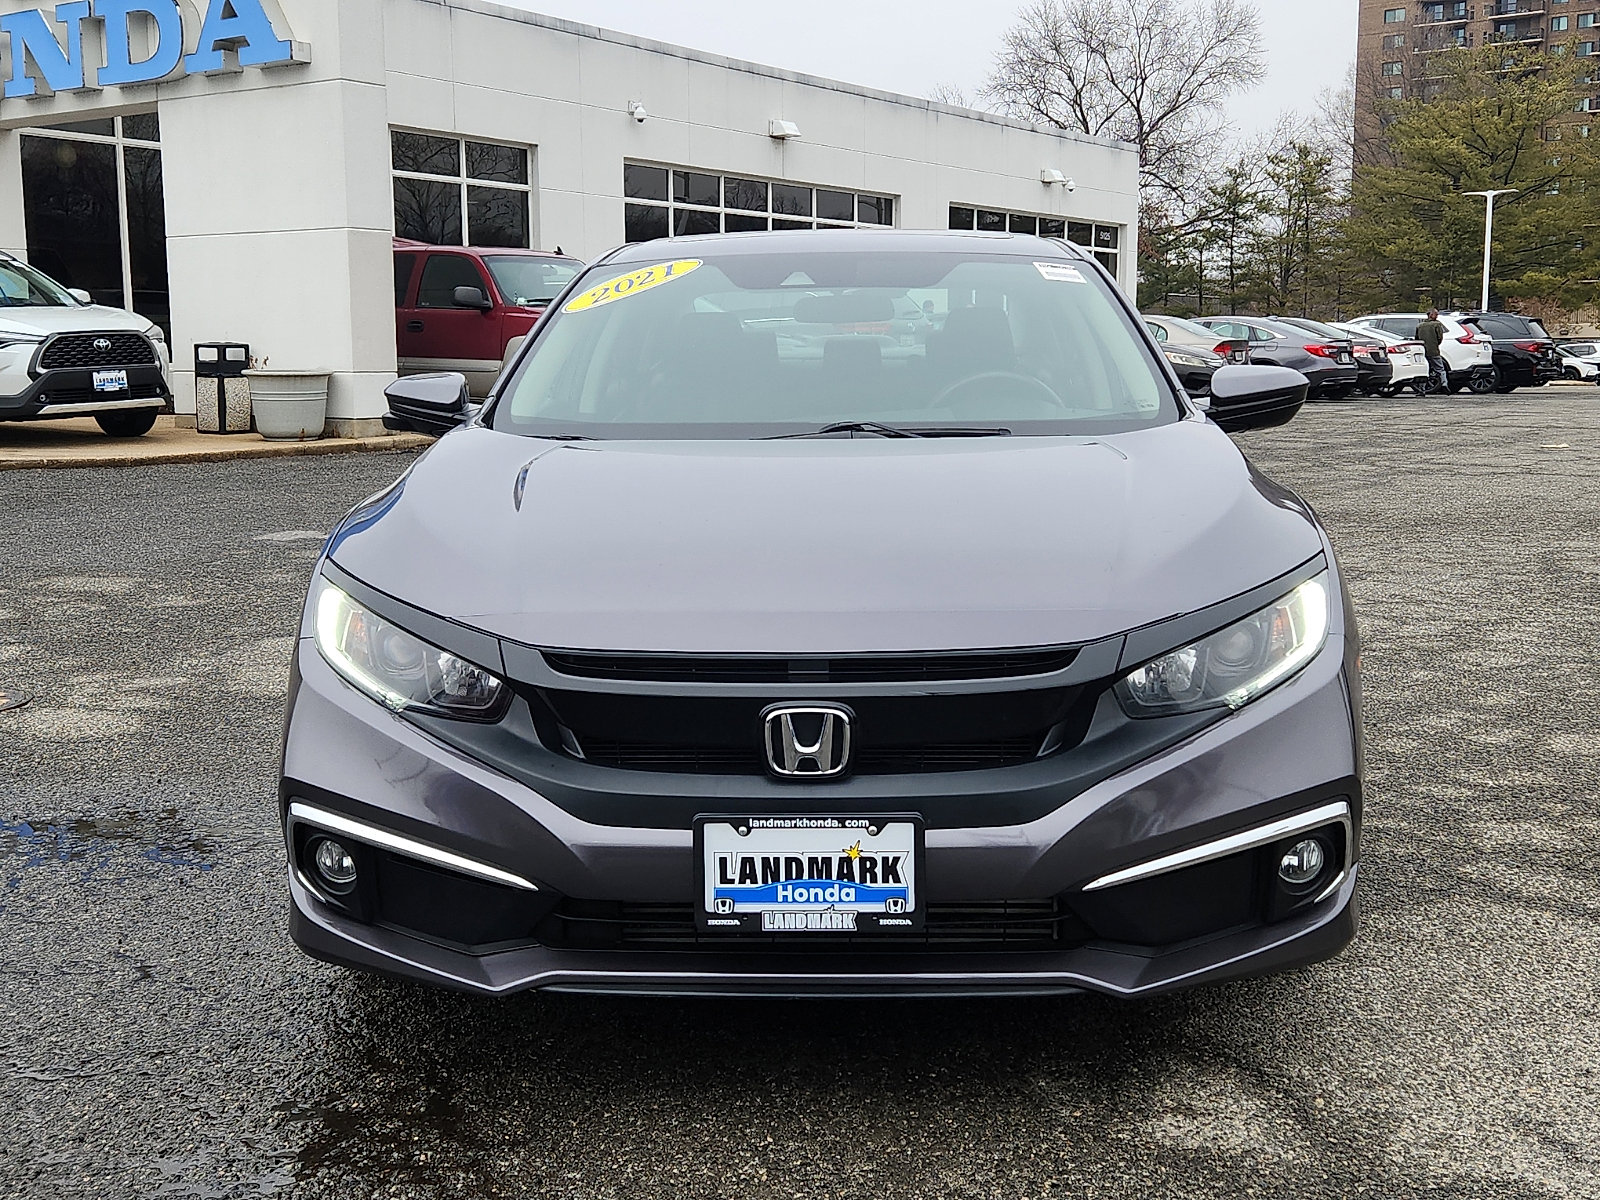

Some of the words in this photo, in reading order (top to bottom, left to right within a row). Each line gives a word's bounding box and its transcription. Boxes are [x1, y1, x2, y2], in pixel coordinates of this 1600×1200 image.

[591, 263, 674, 304] 2021
[718, 856, 901, 884] LANDMARK
[777, 885, 856, 902] Honda
[764, 913, 855, 929] LANDMARK
